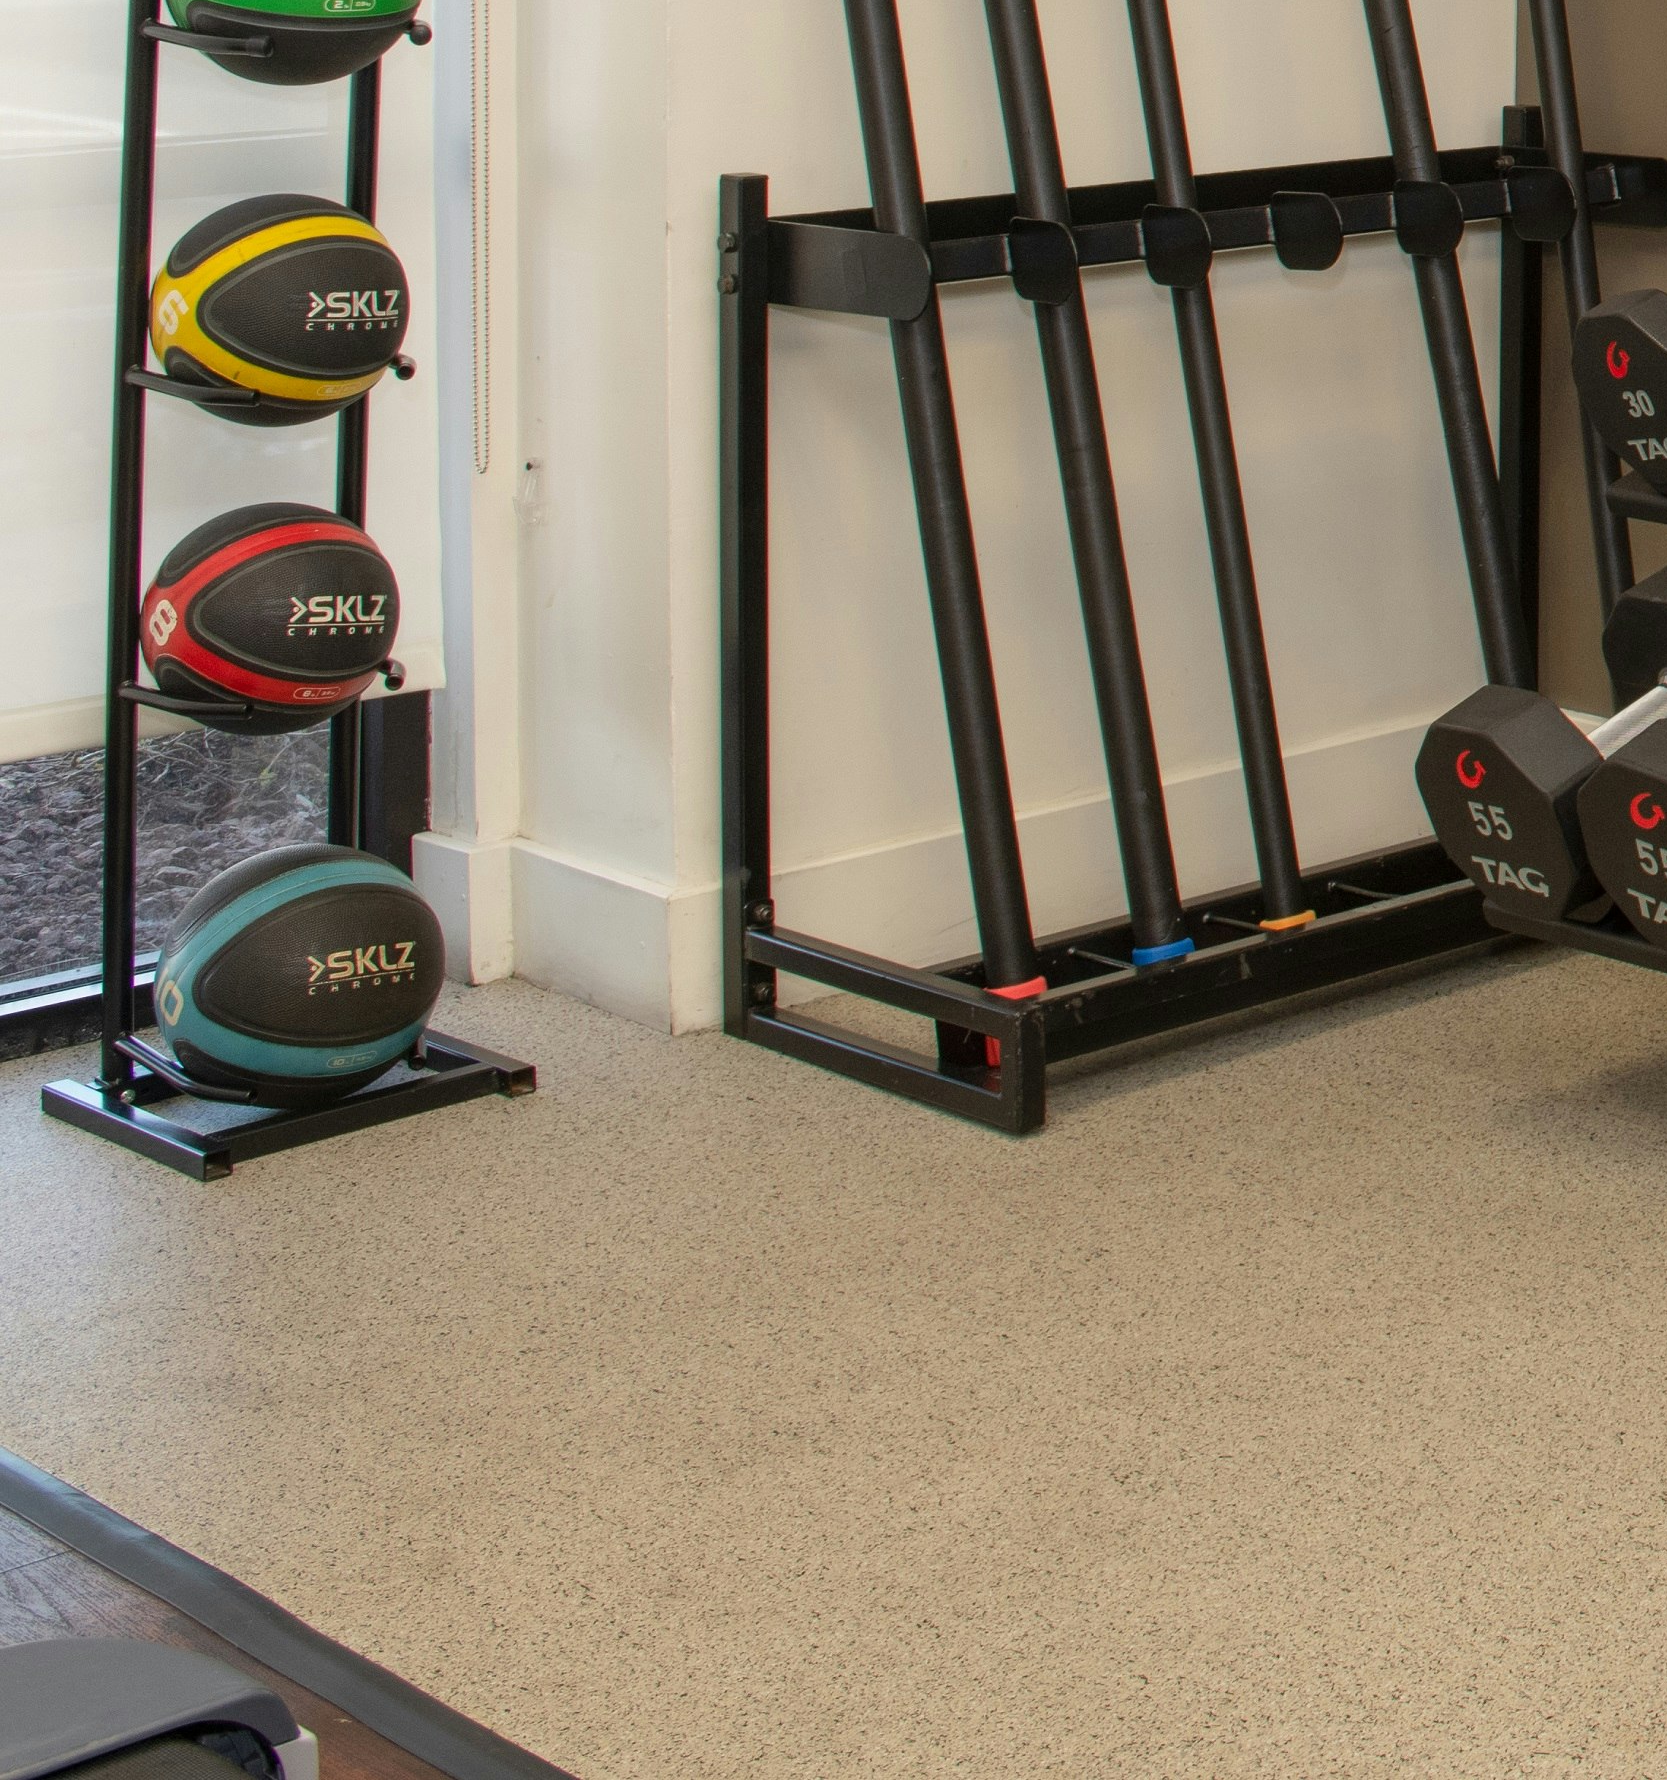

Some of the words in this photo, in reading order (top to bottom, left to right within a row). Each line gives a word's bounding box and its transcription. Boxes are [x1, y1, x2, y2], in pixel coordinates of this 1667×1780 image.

[327, 289, 399, 317] SKLZ
[309, 595, 386, 622] SKLZ
[328, 941, 415, 980] SKLZ
